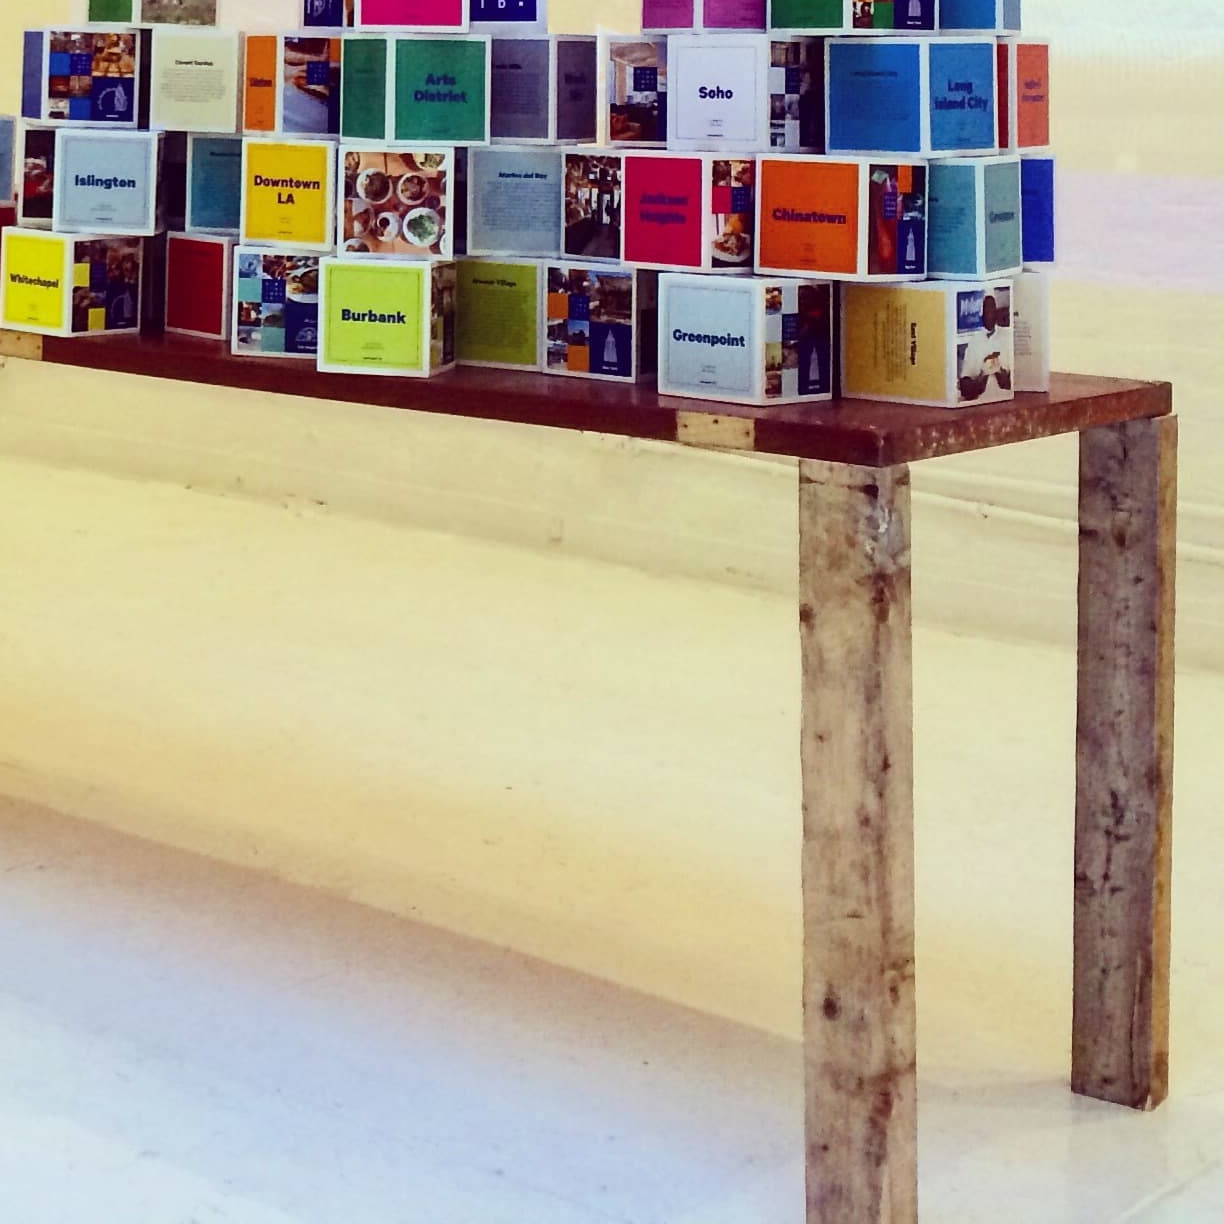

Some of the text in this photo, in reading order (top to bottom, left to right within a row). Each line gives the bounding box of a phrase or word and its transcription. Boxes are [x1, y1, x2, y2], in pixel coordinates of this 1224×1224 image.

[426, 73, 457, 86] Arts
[947, 78, 973, 94] Long
[413, 89, 468, 104] District
[698, 86, 734, 99] Soho
[934, 96, 988, 112] Island City
[74, 174, 136, 190] Islington
[254, 175, 321, 190] Downtown
[277, 192, 295, 205] LA
[772, 207, 847, 225] Chinatown
[10, 273, 59, 288] Whitechapel
[341, 308, 406, 324] Burbank
[673, 328, 745, 347] Greenpoint
